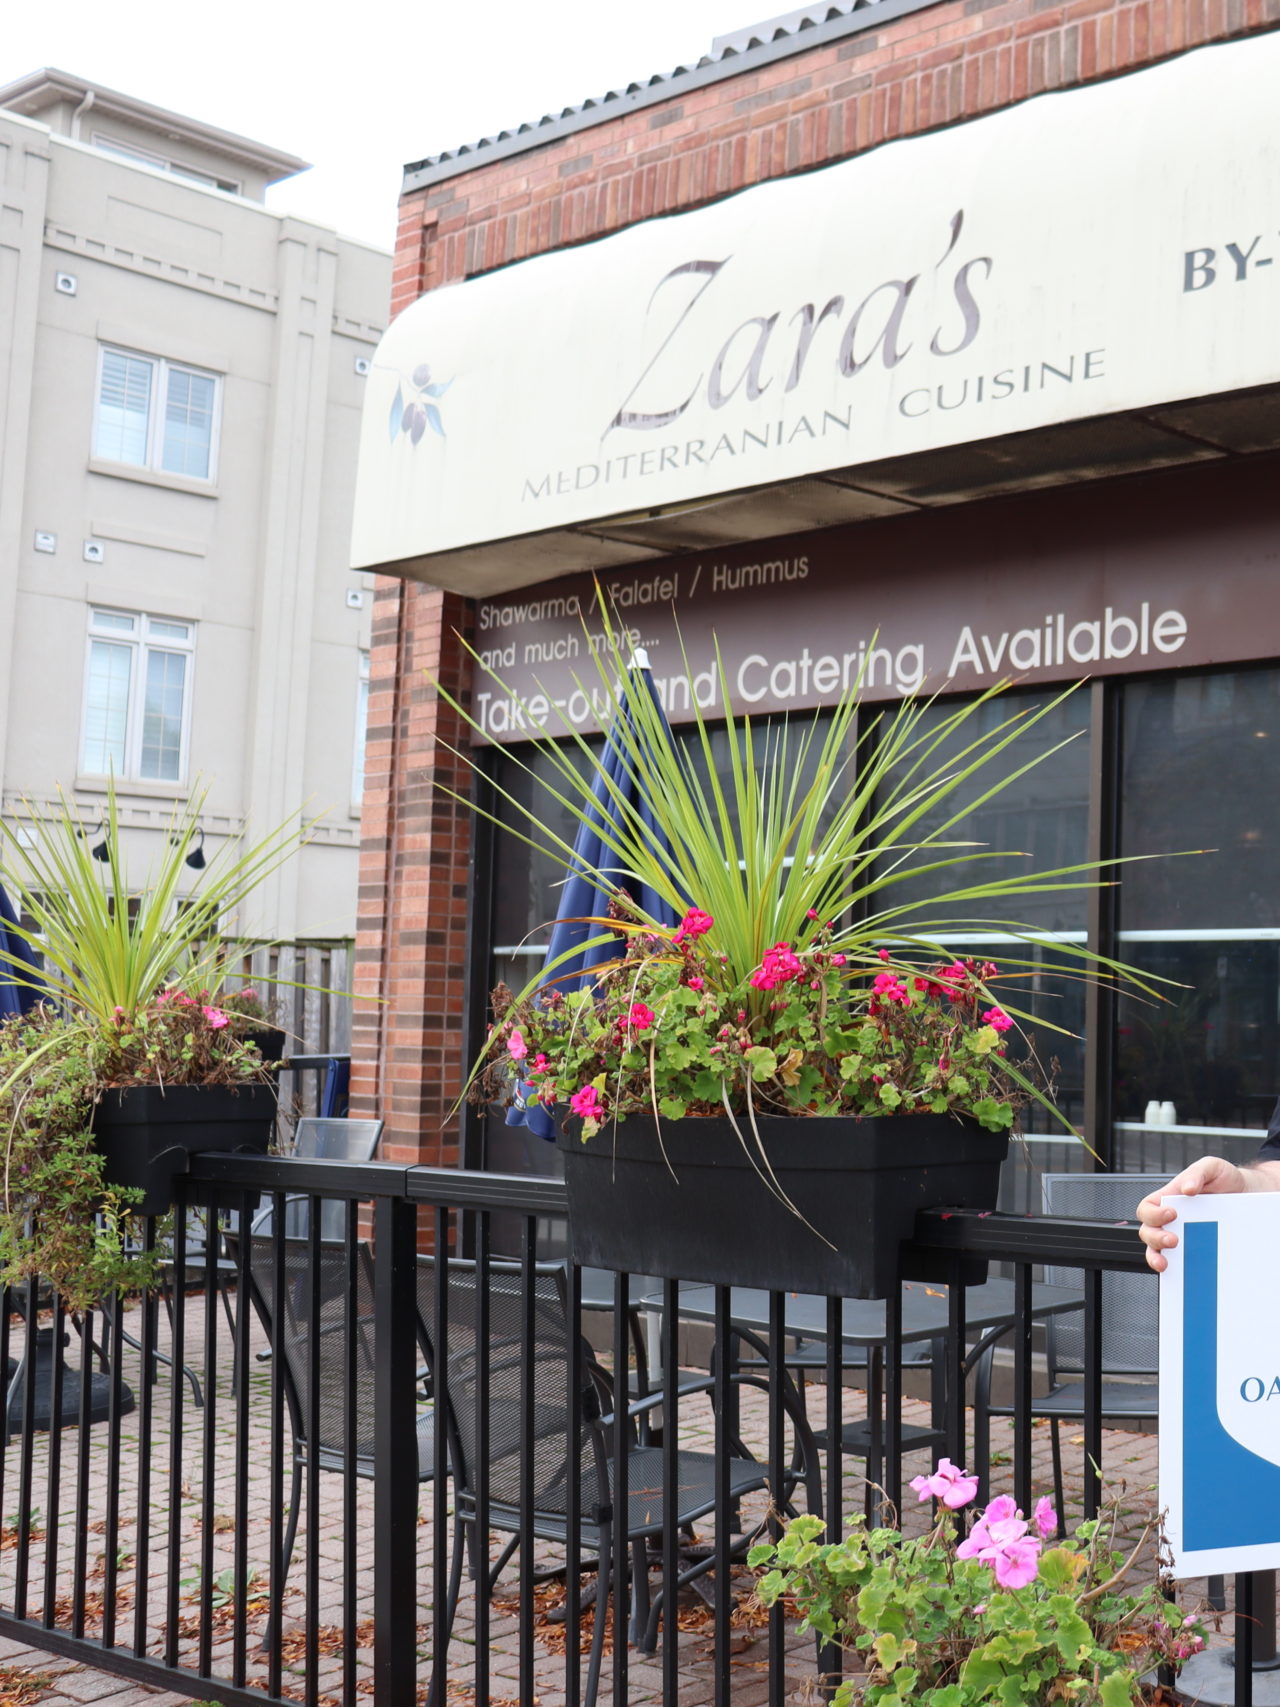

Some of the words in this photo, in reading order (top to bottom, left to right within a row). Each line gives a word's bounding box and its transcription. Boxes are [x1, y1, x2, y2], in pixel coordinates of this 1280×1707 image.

[600, 208, 993, 443] Zara's
[520, 405, 854, 503] MEDITERRANIAN
[898, 348, 1107, 419] CUISINE
[479, 594, 580, 630] Shawarma
[610, 572, 678, 608] Falafel
[712, 556, 809, 592] Hummus
[480, 642, 515, 671] and
[525, 633, 578, 661] much
[737, 641, 924, 695] Catering
[948, 602, 1188, 677] Available
